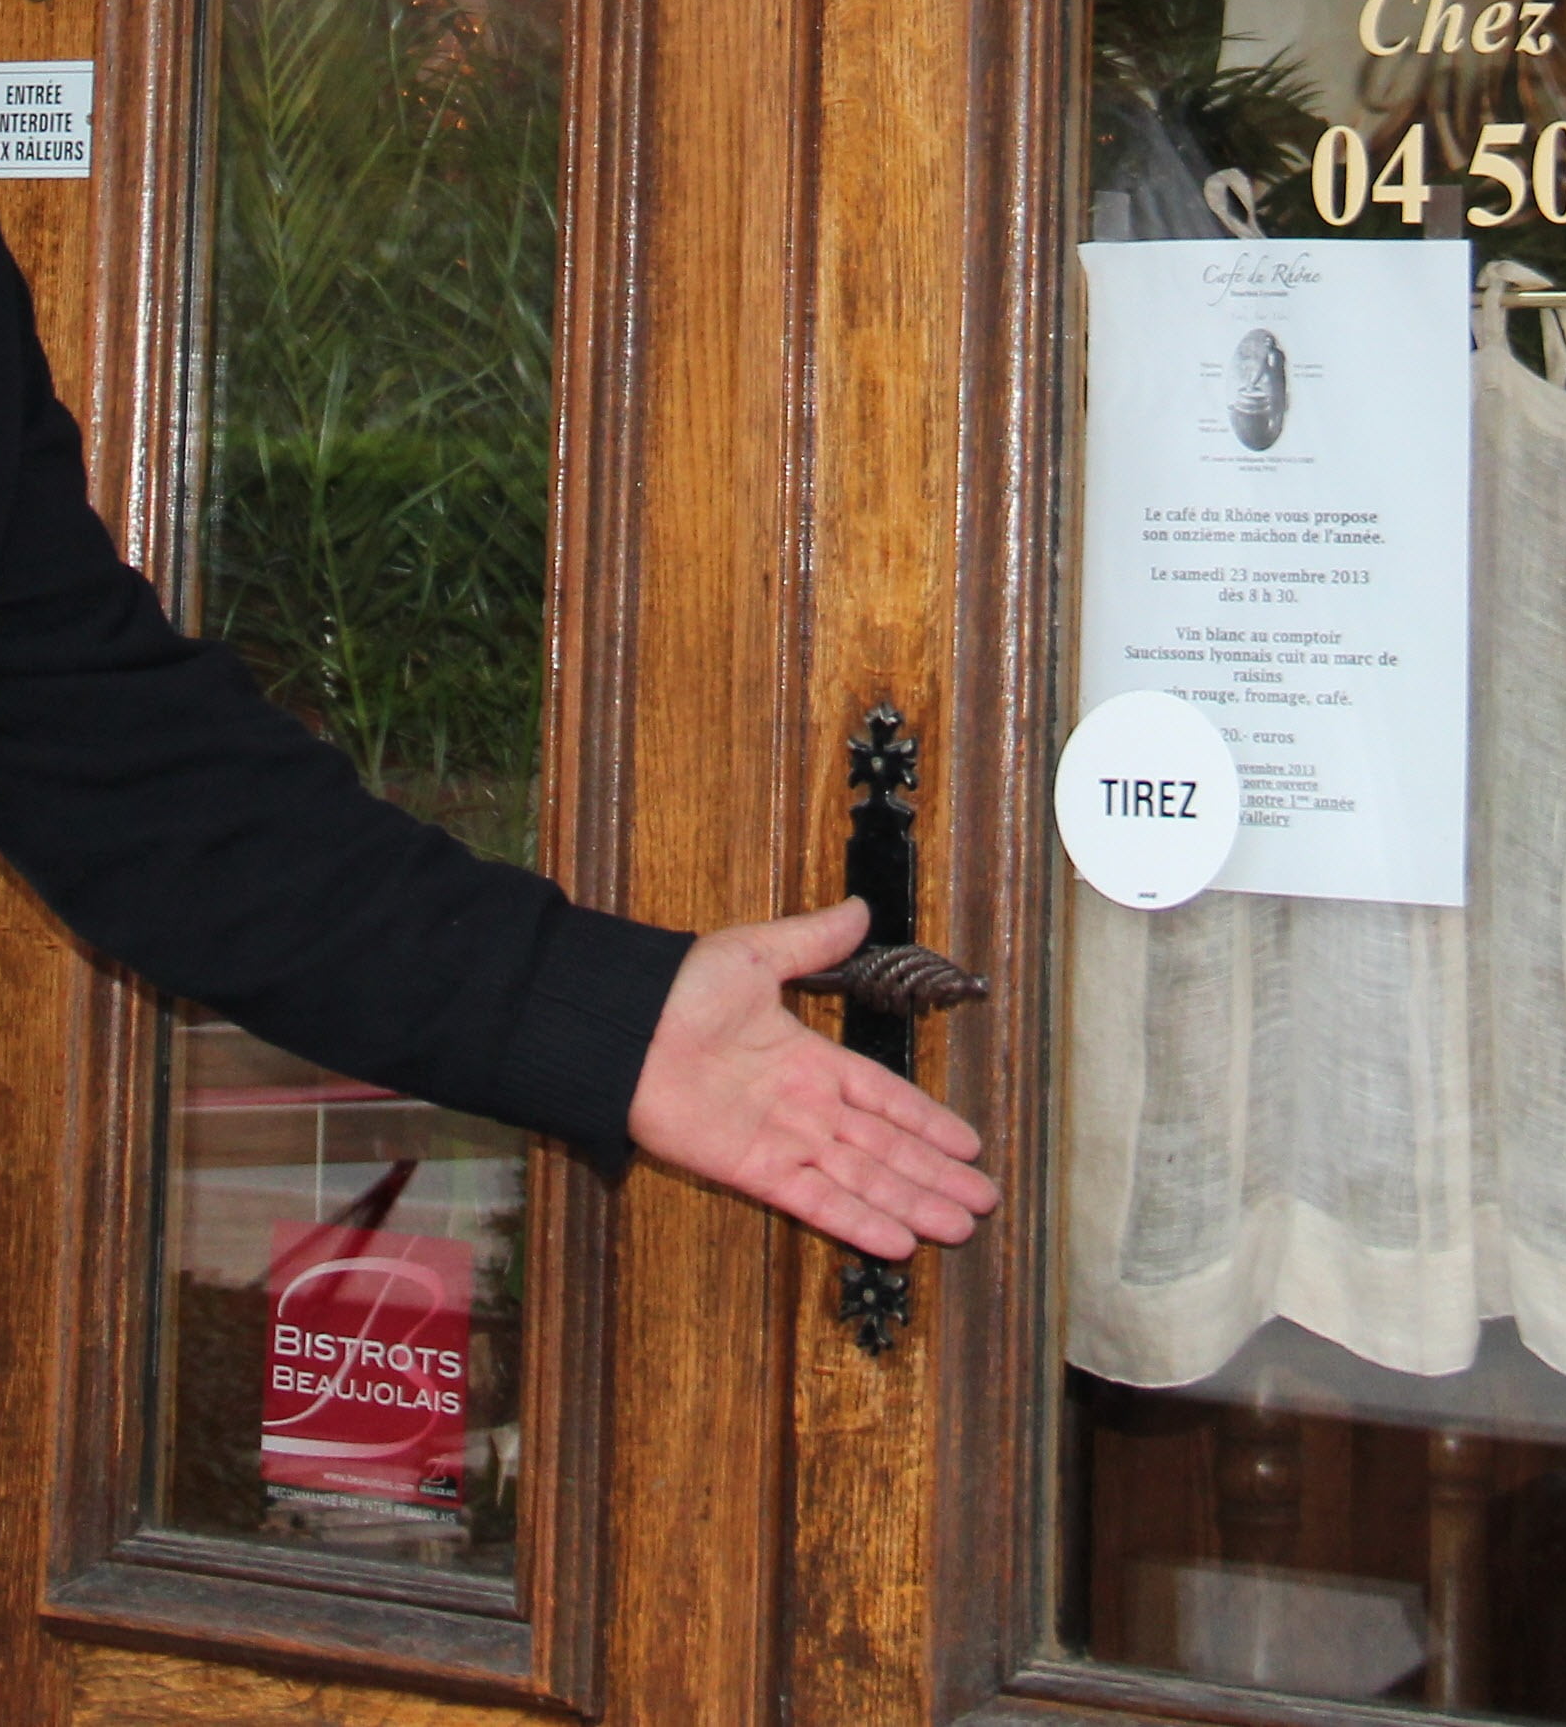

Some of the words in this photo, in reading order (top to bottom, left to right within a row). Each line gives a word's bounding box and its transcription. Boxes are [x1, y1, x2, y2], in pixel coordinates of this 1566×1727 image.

[6, 79, 62, 105] ENTRÉE
[15, 136, 84, 161] RÂLEURS
[1310, 123, 1432, 227] 04
[1202, 252, 1250, 306] Café
[1144, 507, 1161, 522] Le
[1166, 506, 1195, 522] café
[1201, 507, 1219, 522] du
[1225, 507, 1270, 523] Rhône
[1274, 511, 1309, 523] vous
[1314, 511, 1378, 527] propose
[1142, 529, 1168, 541] son
[1173, 527, 1235, 542] onzième
[1240, 527, 1297, 543] mâchon
[1302, 528, 1319, 543] de
[1324, 528, 1386, 544] l'année.
[1150, 566, 1167, 581] Le
[1171, 566, 1224, 582] samedi
[1230, 568, 1247, 582] 23
[1252, 567, 1325, 583] novembre
[1330, 569, 1370, 584] 2013
[1218, 587, 1244, 602] dès
[1248, 589, 1258, 602] 8
[1262, 588, 1271, 603] h
[1276, 589, 1299, 603] 30.
[1175, 626, 1201, 641] Vin
[1205, 626, 1245, 642] blanc
[1250, 631, 1268, 643] au
[1272, 629, 1342, 646] comptoir
[1124, 645, 1205, 661] Saucissons
[1210, 646, 1272, 666] lyonnais
[1276, 648, 1304, 664] cuit
[1310, 652, 1328, 665] au
[1333, 653, 1372, 666] marc
[1378, 650, 1399, 667] de
[1233, 669, 1283, 683] raisins
[1191, 688, 1239, 705] rouge,
[1244, 687, 1311, 706] fromage,
[1316, 688, 1353, 706] café.
[1252, 731, 1295, 744] euros
[1236, 763, 1284, 775] ovembre
[1288, 763, 1316, 776] 2013
[1242, 778, 1273, 790] porte
[1274, 780, 1318, 792] ouverte
[1099, 779, 1197, 818] TIREZ
[1247, 793, 1284, 808] notre
[1313, 795, 1355, 811] année
[273, 1323, 462, 1380] BISTROTS
[272, 1364, 462, 1415] BEAUJOLAIS
[340, 1495, 359, 1509] PAR
